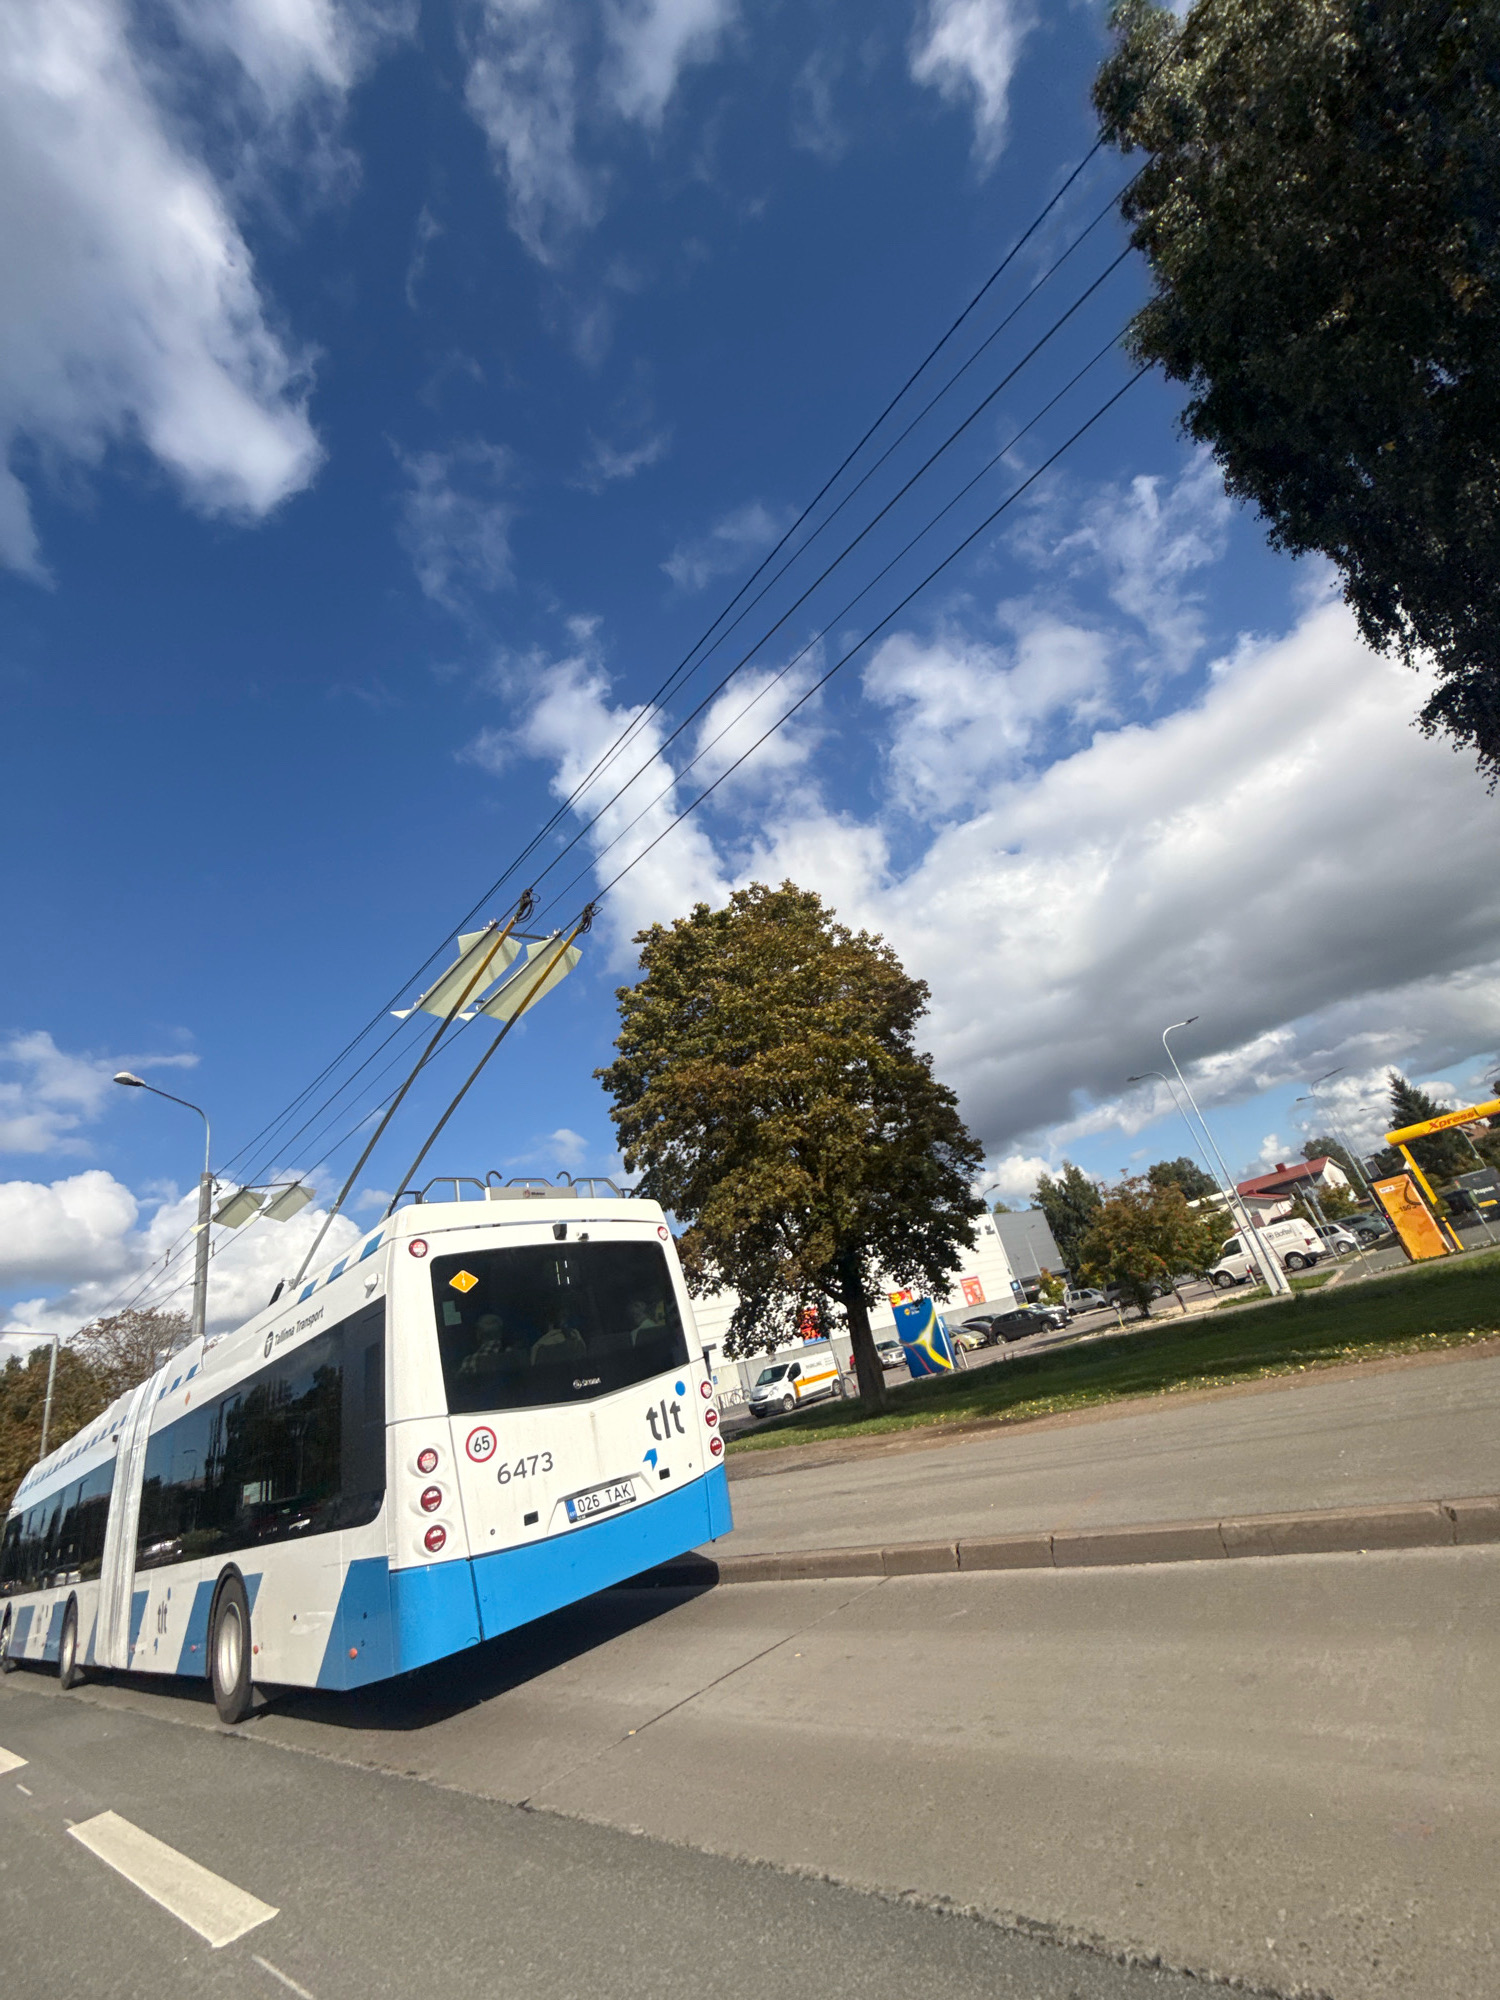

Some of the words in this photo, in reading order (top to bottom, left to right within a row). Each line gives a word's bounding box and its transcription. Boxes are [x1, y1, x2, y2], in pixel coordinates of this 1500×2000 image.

[1428, 1111, 1475, 1132] Xpress
[275, 1326, 295, 1346] Tallinna
[296, 1305, 324, 1333] Transport
[645, 1399, 686, 1441] tlt
[473, 1435, 490, 1453] 65
[497, 1451, 554, 1485] 6473
[577, 1494, 600, 1513] 026
[605, 1483, 632, 1503] TAK
